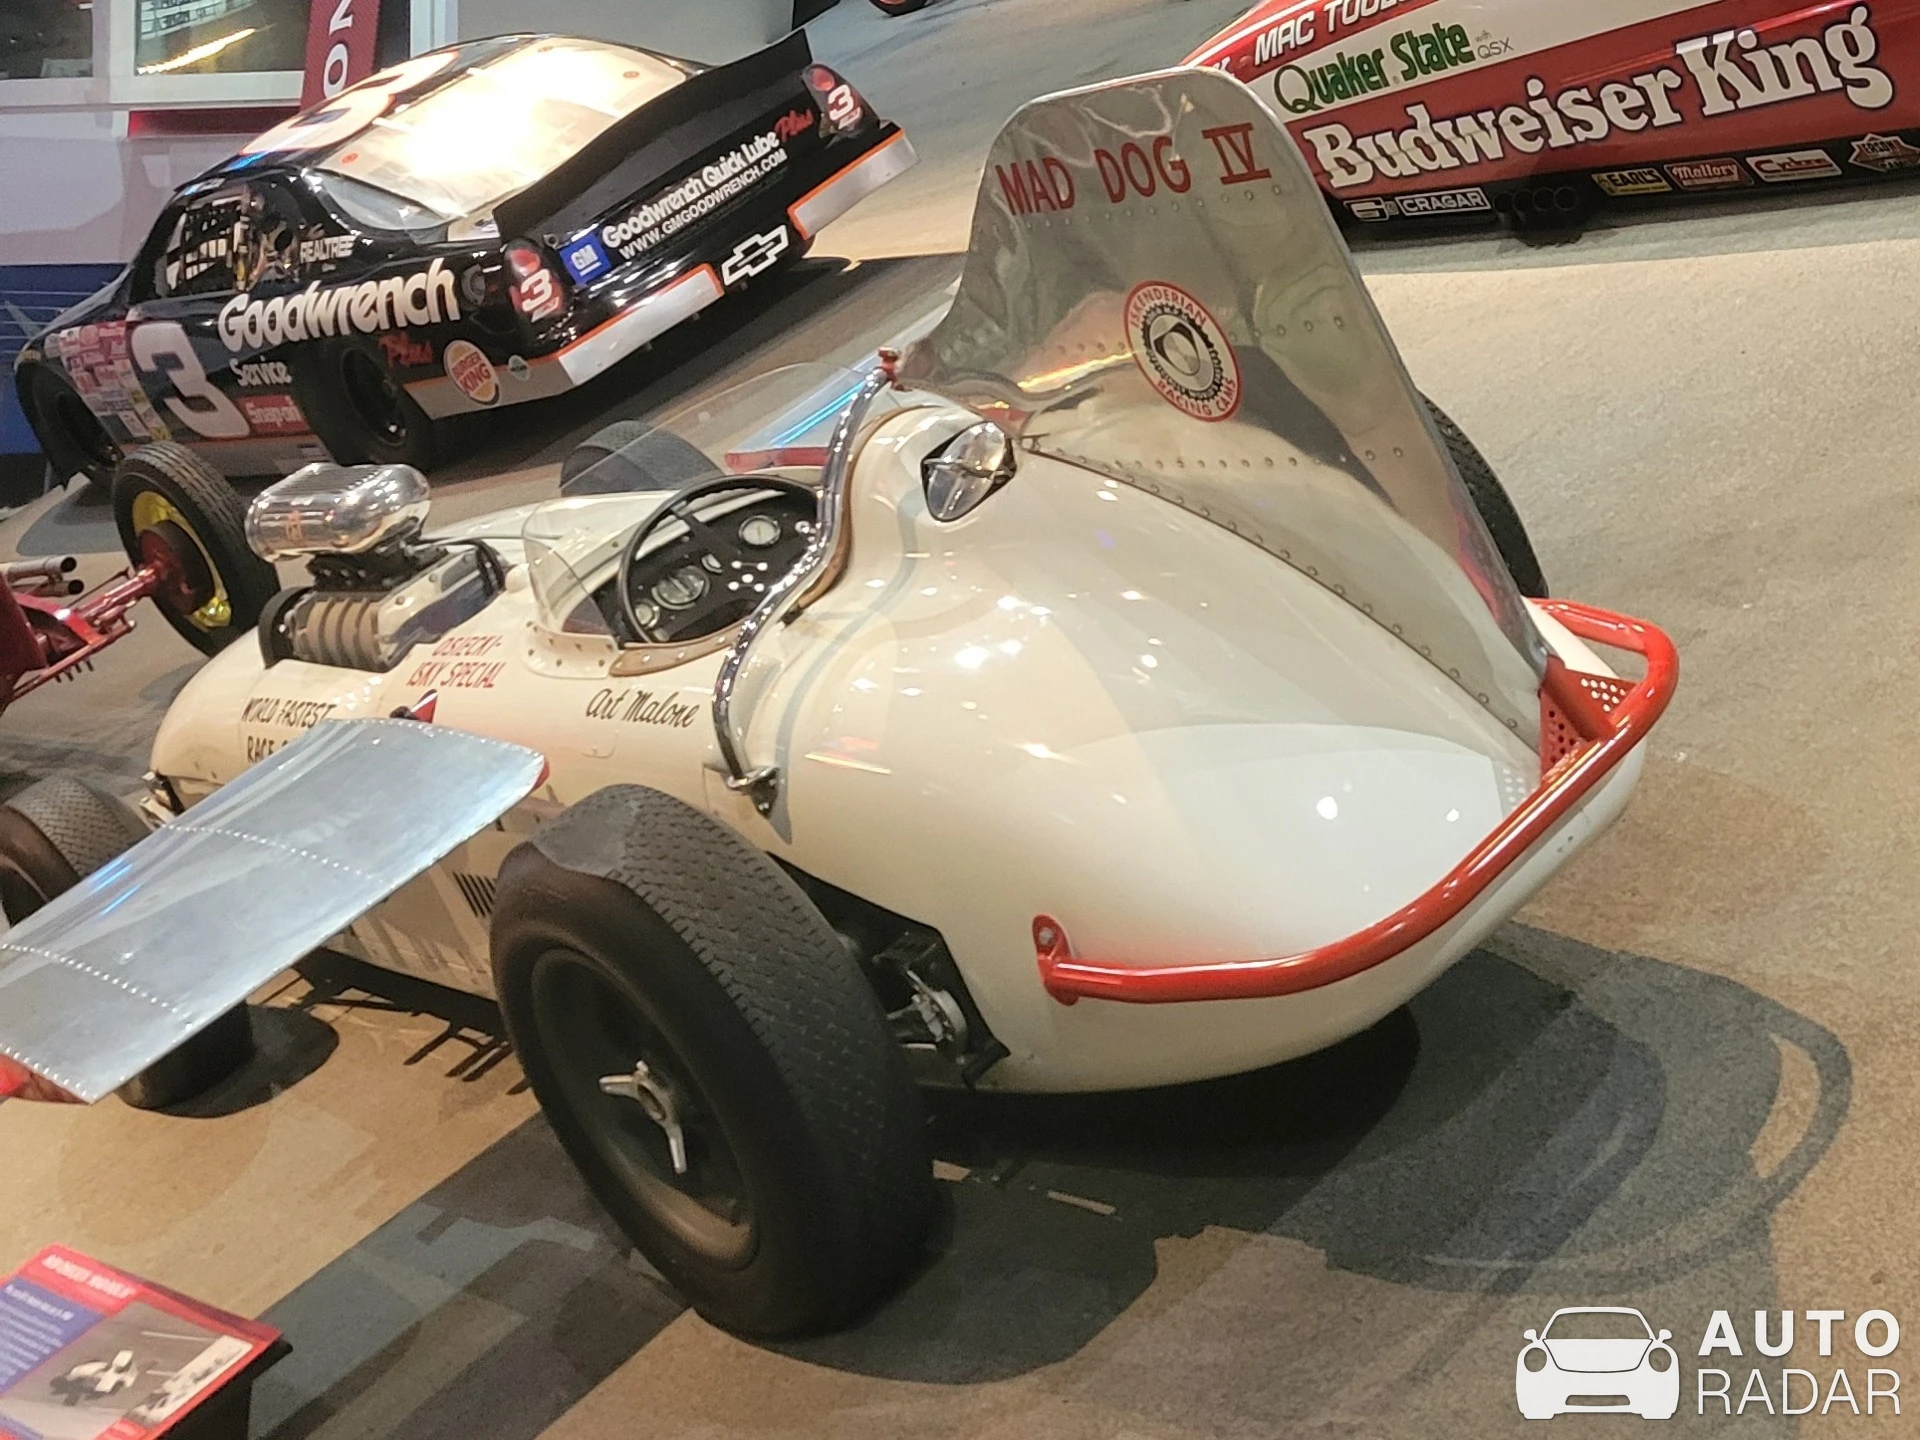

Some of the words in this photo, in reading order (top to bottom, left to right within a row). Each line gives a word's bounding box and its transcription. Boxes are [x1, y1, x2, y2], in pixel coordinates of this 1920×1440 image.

[1254, 11, 1314, 66] MAC
[1477, 36, 1514, 59] QSX
[1273, 48, 1390, 114] Quaker
[1390, 22, 1476, 82] State
[827, 84, 854, 121] 3
[1304, 66, 1686, 190] Budweiser
[1675, 4, 1895, 117] King
[995, 156, 1076, 216] MAD
[1093, 135, 1192, 204] DOG
[1201, 122, 1272, 185] IV
[1606, 170, 1664, 187] EARL'S
[1671, 163, 1739, 180] Mallory
[602, 177, 704, 248] Goodwrench
[702, 151, 748, 187] Quick
[741, 131, 780, 163] Lube
[619, 148, 788, 260] WWW.GMGOODWRENCH.COM
[1402, 191, 1484, 213] CRAGAR
[300, 235, 357, 264] REALTREE
[571, 244, 599, 270] GM
[218, 257, 461, 352] Goodwrench
[520, 269, 552, 312] 3
[1130, 287, 1207, 328] ISKENDERIAN
[131, 321, 250, 438] 3
[230, 354, 292, 387] Service
[452, 351, 481, 380] BURGER
[460, 363, 491, 391] KING
[1157, 380, 1212, 416] RACING
[1216, 377, 1236, 412] CAMS
[406, 662, 451, 687] ISKY
[440, 662, 507, 688] SPECIAL
[241, 697, 280, 723] WORLD
[276, 699, 338, 728] FASTEST
[586, 688, 630, 720] Art
[622, 690, 700, 728] Malone
[247, 735, 275, 763] RACE
